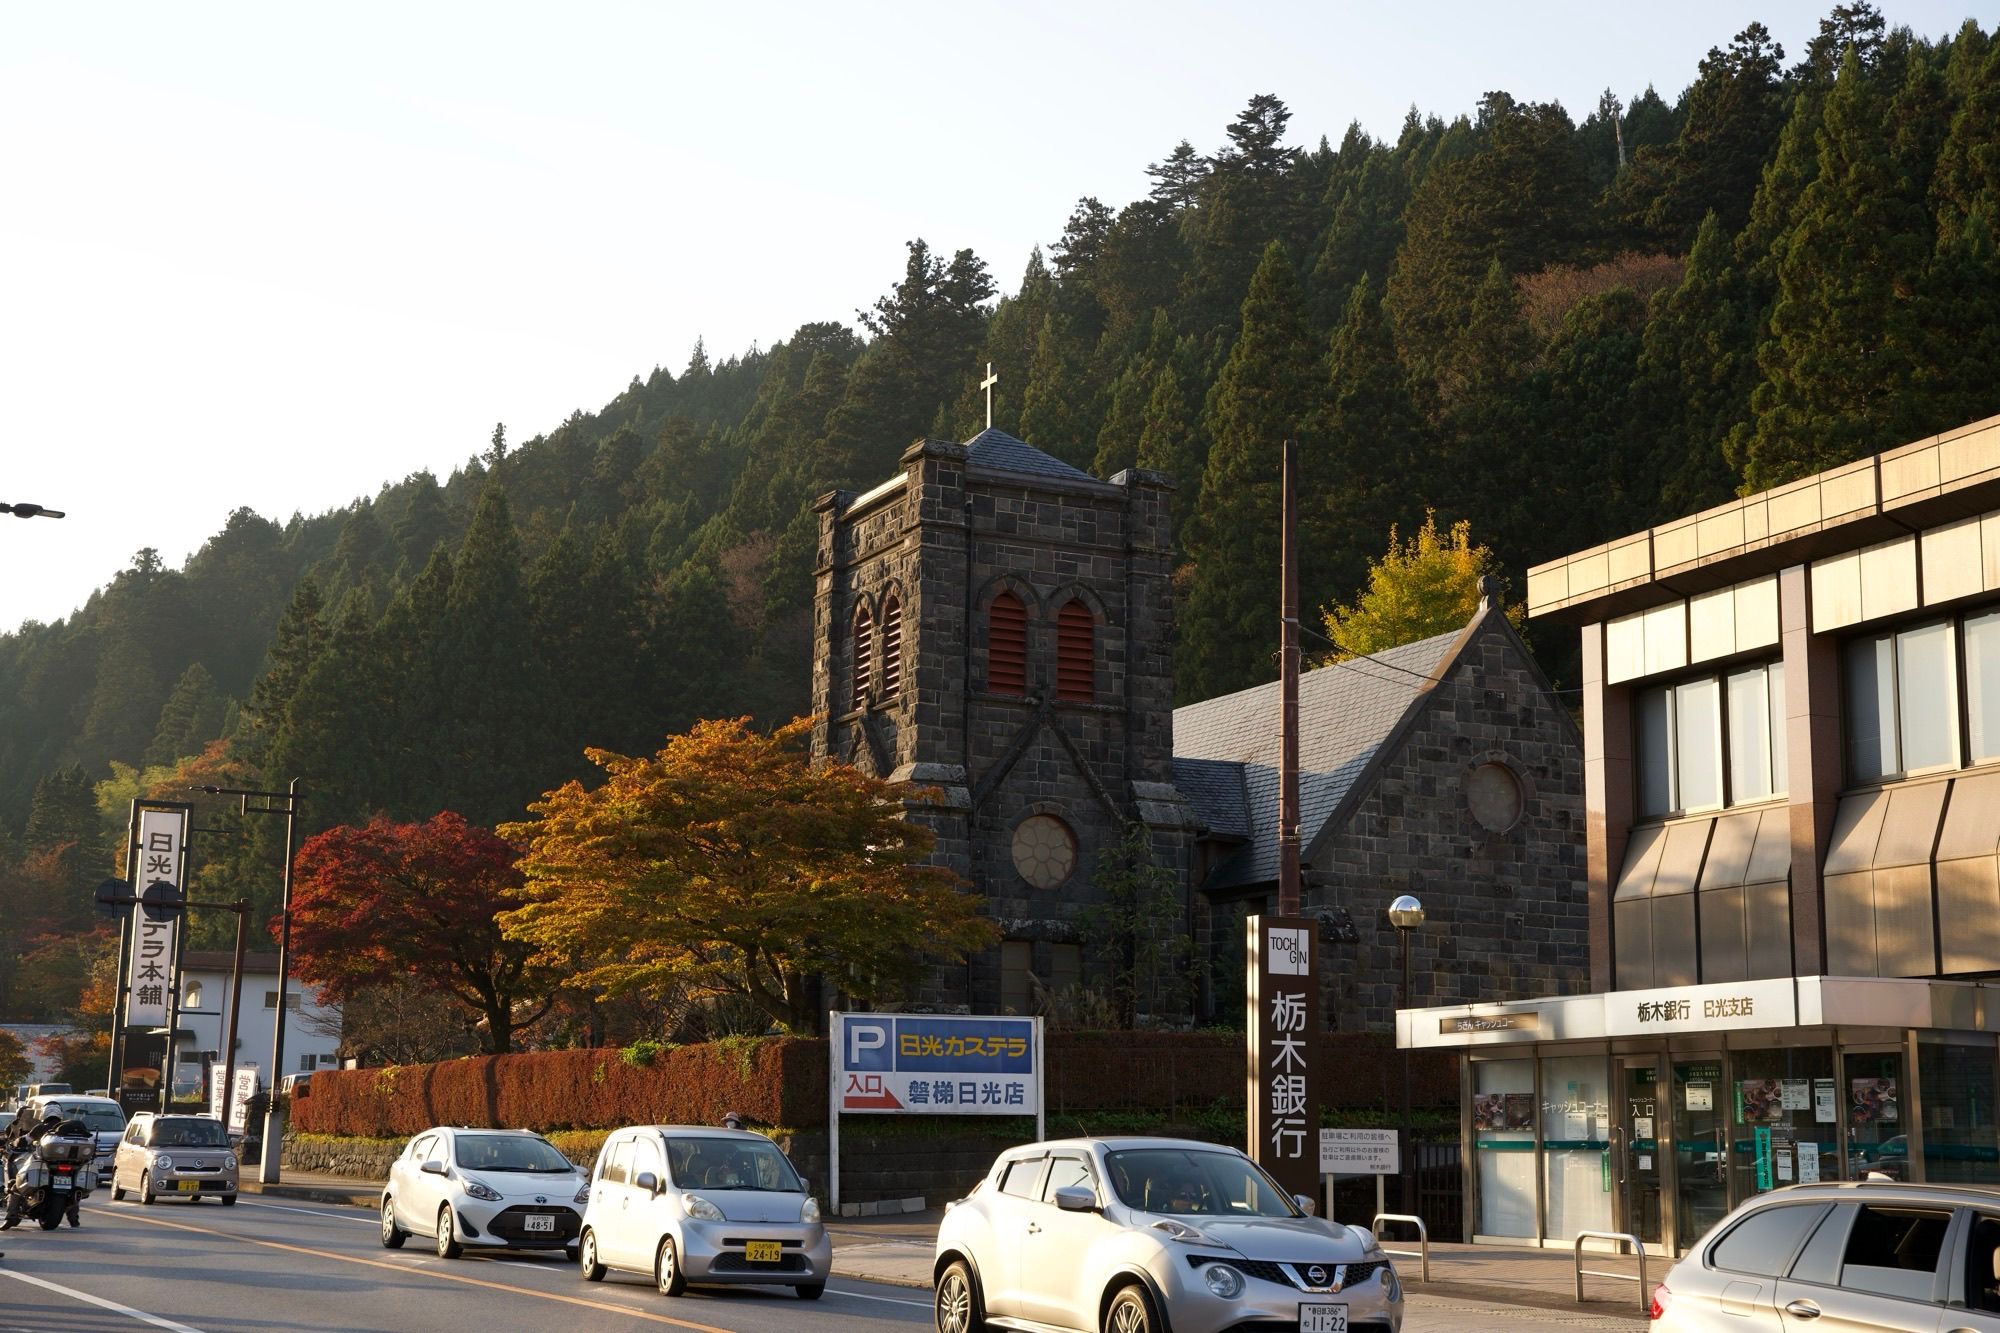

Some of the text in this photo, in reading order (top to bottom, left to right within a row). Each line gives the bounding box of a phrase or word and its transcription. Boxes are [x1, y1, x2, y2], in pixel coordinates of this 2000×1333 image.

[136, 832, 173, 1006] 日光テラ本舗
[1637, 996, 1754, 1022] 栃木銀行 日光支店
[851, 1025, 886, 1064] P
[900, 1034, 1028, 1057] 日光カステラ
[846, 1073, 882, 1094] 入口
[1271, 990, 1307, 1158] 栃木銀行
[235, 1074, 251, 1124] 営業中
[908, 1080, 1025, 1105] 磐梯日光店
[1542, 1100, 1608, 1114] キャッシュコーナー
[1632, 1104, 1654, 1117] 入口
[530, 1221, 552, 1230] 48-51
[753, 1249, 780, 1260] 24-19
[1313, 1316, 1345, 1332] 11-22
